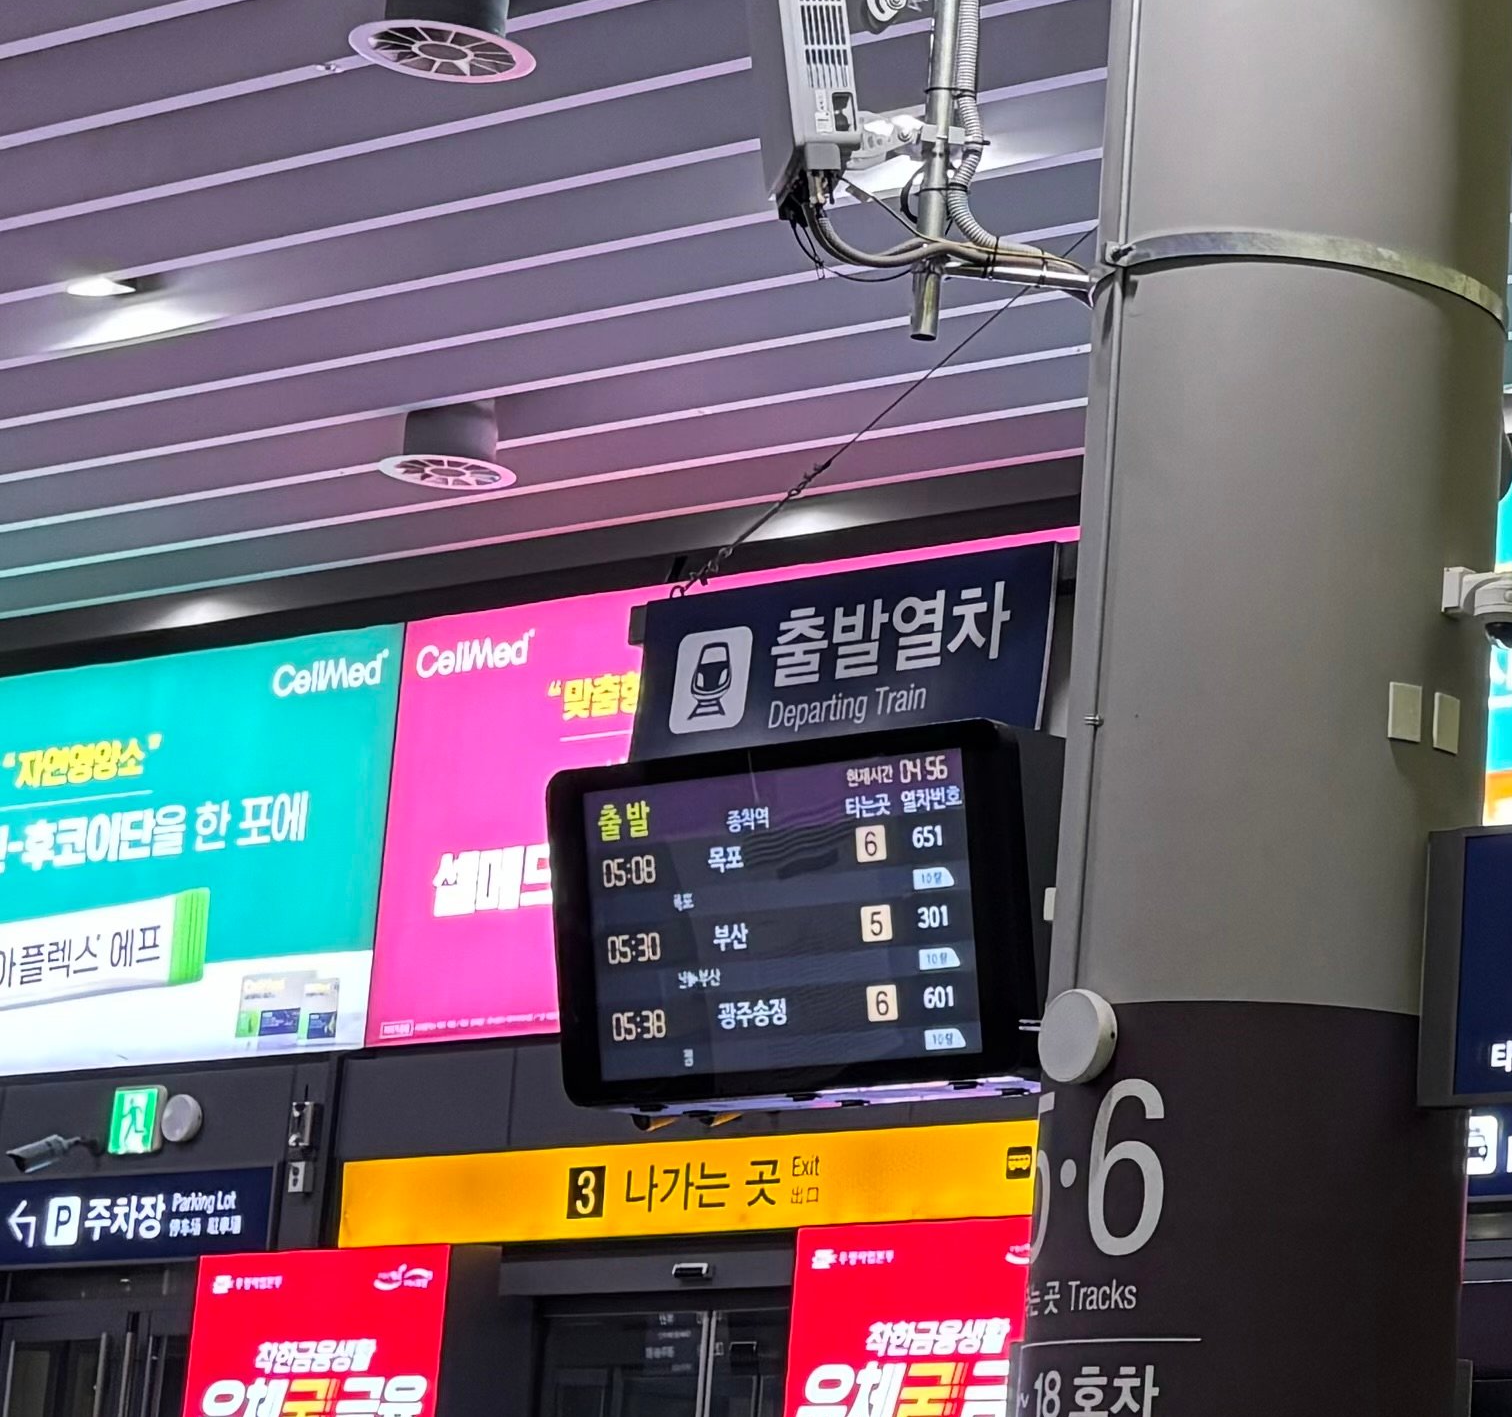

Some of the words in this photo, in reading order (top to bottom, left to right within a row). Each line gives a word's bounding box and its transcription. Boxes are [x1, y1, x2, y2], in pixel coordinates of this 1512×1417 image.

[415, 629, 535, 678] CellMed
[771, 580, 1011, 688] 출발열차
[272, 648, 389, 697] CellMed
[768, 698, 867, 731] Departing
[875, 685, 926, 714] Train
[0, 804, 186, 874] -후코이단을
[195, 801, 231, 852] 한
[239, 792, 309, 845] 포에
[598, 801, 650, 841] 출발
[726, 807, 769, 832] 종착역
[845, 793, 891, 818] 타는곳
[901, 786, 962, 813] 열차번호
[602, 854, 656, 888] 05:08
[708, 846, 744, 873] 목포
[864, 831, 878, 857] 6
[912, 825, 943, 848] 651
[110, 925, 161, 968] 에프
[608, 932, 661, 964] 05:30
[713, 922, 748, 951] 부산
[870, 911, 883, 936] 5
[917, 905, 949, 928] 301
[612, 1009, 666, 1041] 05:38
[718, 998, 787, 1029] 광주송정
[876, 991, 889, 1015] 6
[923, 986, 954, 1009] 601
[574, 1169, 596, 1215] 3
[626, 1161, 730, 1212] 나가는
[745, 1159, 781, 1206] 곳
[792, 1155, 820, 1177] Exit
[84, 1194, 166, 1242] 주차장
[171, 1192, 214, 1214] Parking
[217, 1191, 236, 1210] Lot
[790, 1186, 820, 1206] 出口
[1044, 1281, 1061, 1315] 곳
[1068, 1279, 1137, 1311] Tracks
